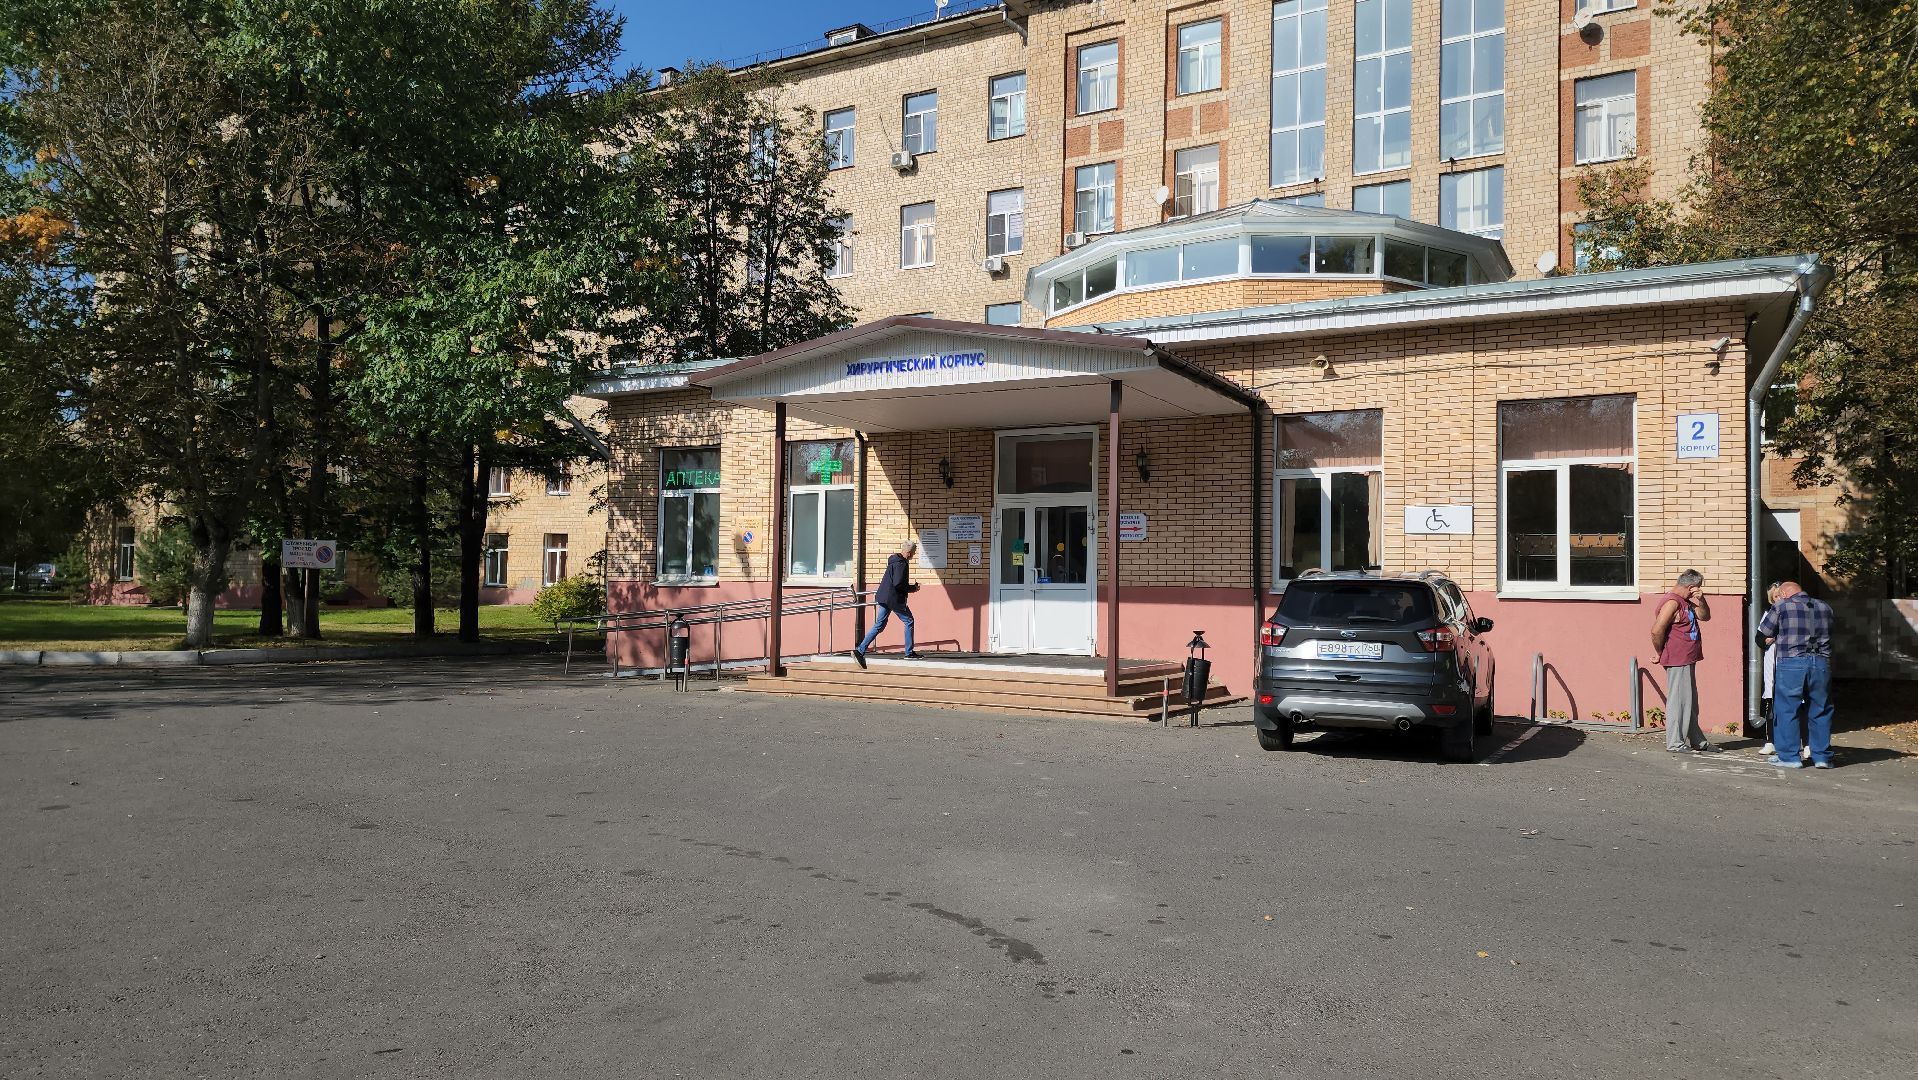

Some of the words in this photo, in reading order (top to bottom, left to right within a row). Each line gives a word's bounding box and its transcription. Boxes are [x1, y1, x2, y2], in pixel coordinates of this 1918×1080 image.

[846, 354, 936, 376] ХИРУРГИЧЕСКИЙ
[939, 352, 985, 369] КОРПУС
[1691, 421, 1705, 441] 2
[1680, 444, 1717, 452] КОРПУС
[665, 470, 720, 487] АПТЕКА
